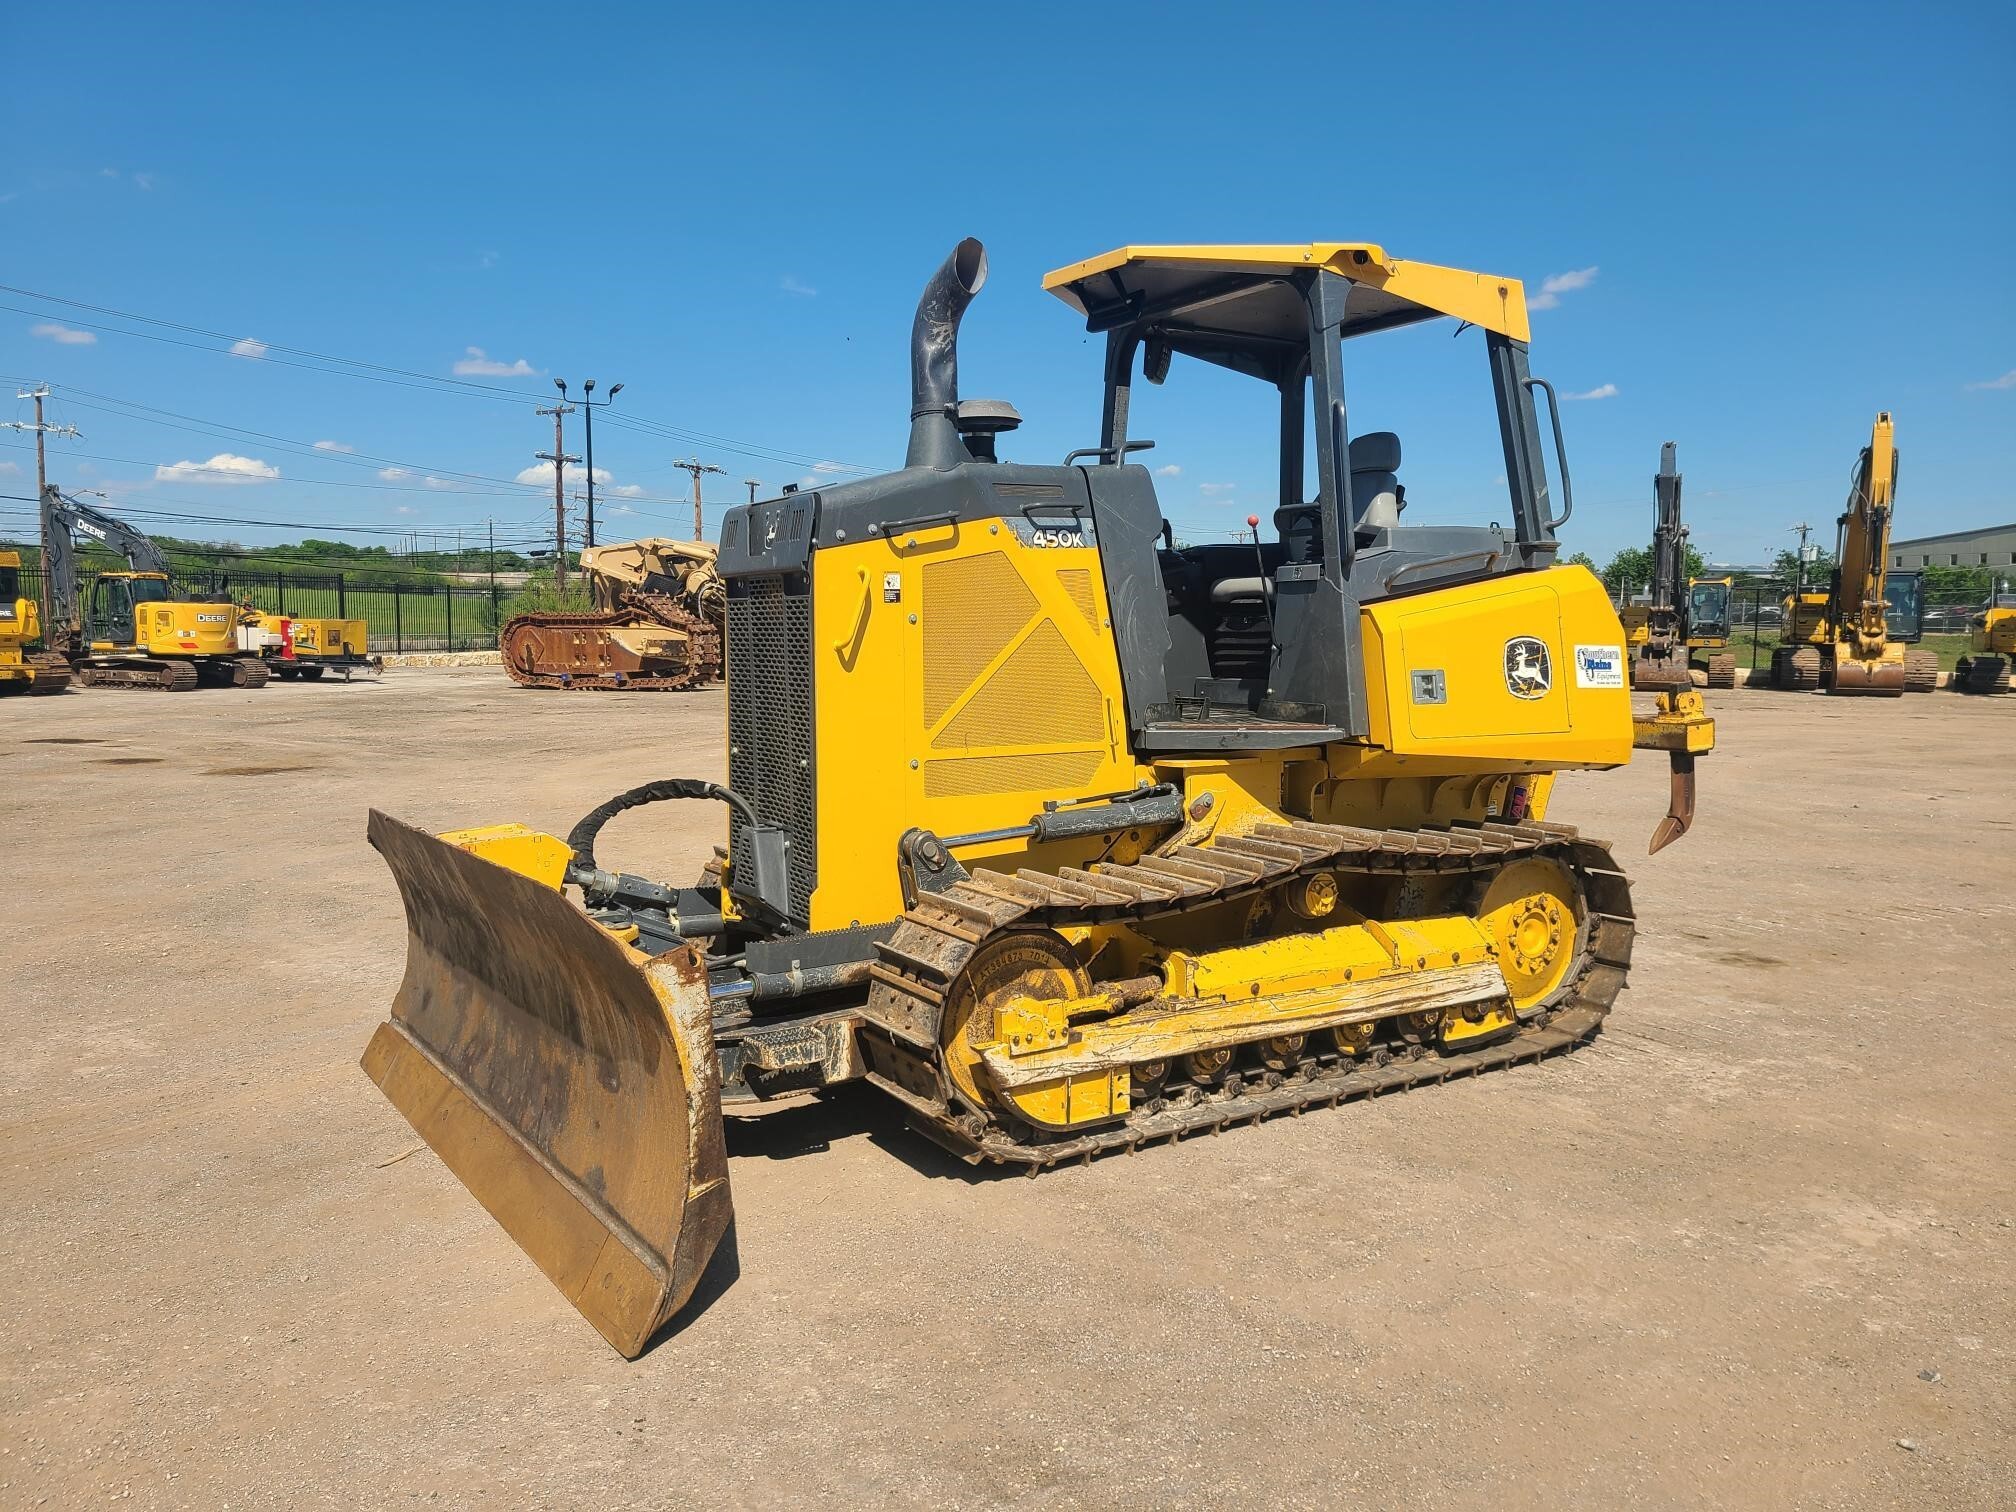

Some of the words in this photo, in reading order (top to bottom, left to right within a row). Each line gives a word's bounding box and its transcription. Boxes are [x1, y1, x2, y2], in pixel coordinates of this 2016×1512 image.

[77, 518, 107, 540] DEERE
[1033, 529, 1086, 548] 450K
[196, 613, 227, 622] DEERE
